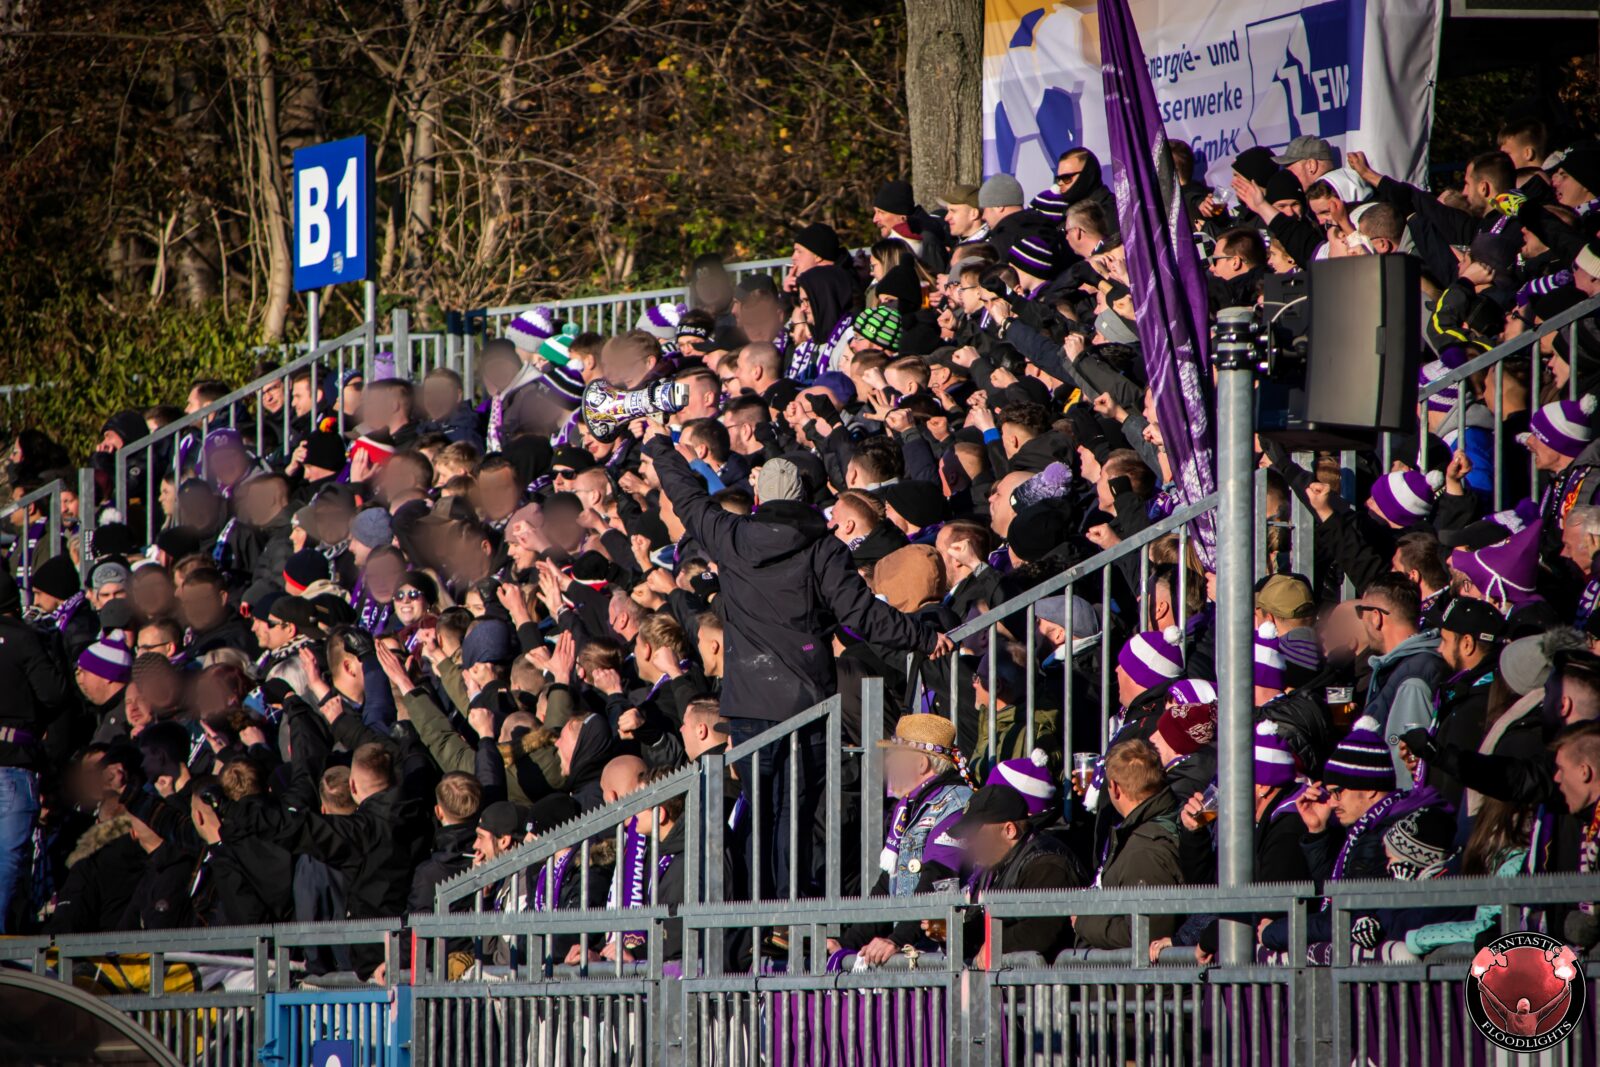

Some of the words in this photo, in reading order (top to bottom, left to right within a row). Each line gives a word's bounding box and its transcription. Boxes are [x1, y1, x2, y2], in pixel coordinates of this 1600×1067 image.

[1147, 43, 1201, 83] nergie-
[1206, 30, 1240, 67] und
[1158, 81, 1242, 123] serwerke
[299, 156, 358, 268] B1
